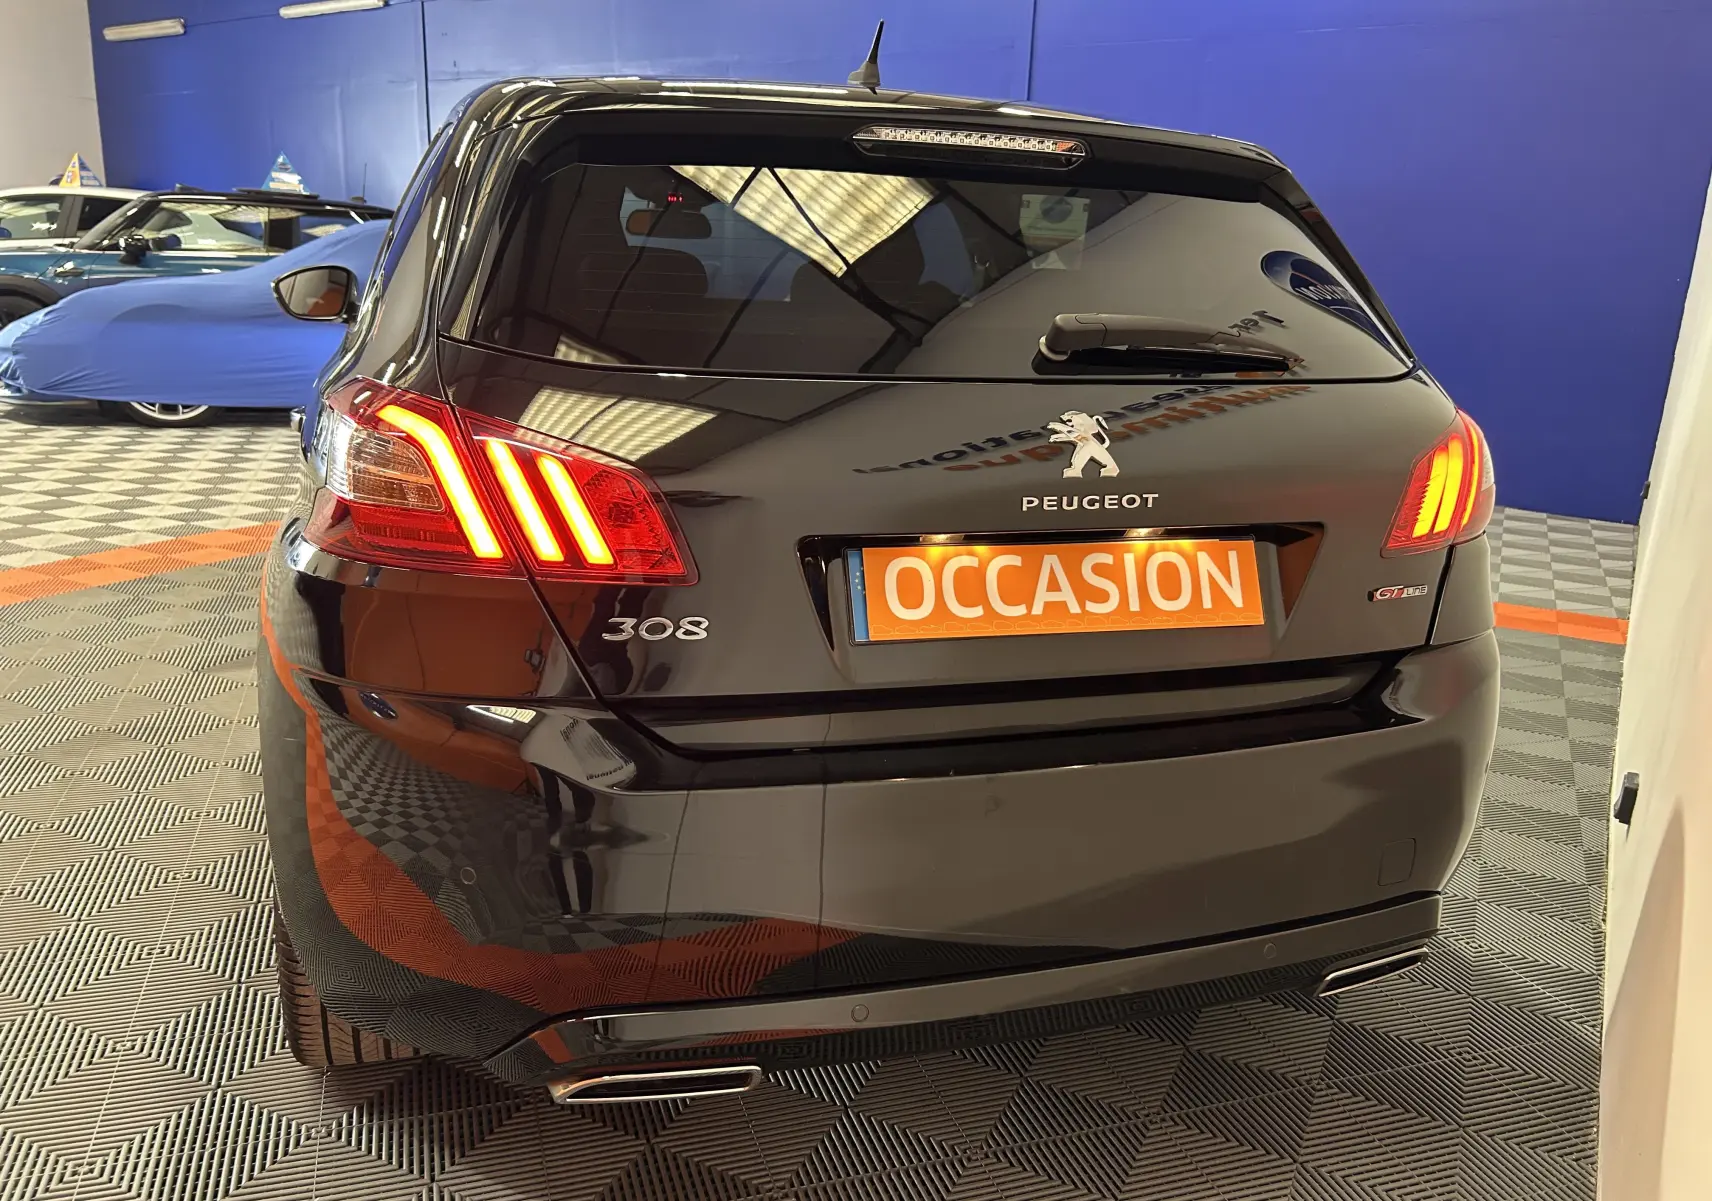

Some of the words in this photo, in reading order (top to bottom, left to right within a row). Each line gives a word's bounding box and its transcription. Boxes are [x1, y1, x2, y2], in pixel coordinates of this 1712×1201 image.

[1021, 493, 1159, 511] PEUGEOT
[883, 550, 1244, 621] OCCASION
[1375, 585, 1404, 599] GT
[601, 616, 710, 641] 308
